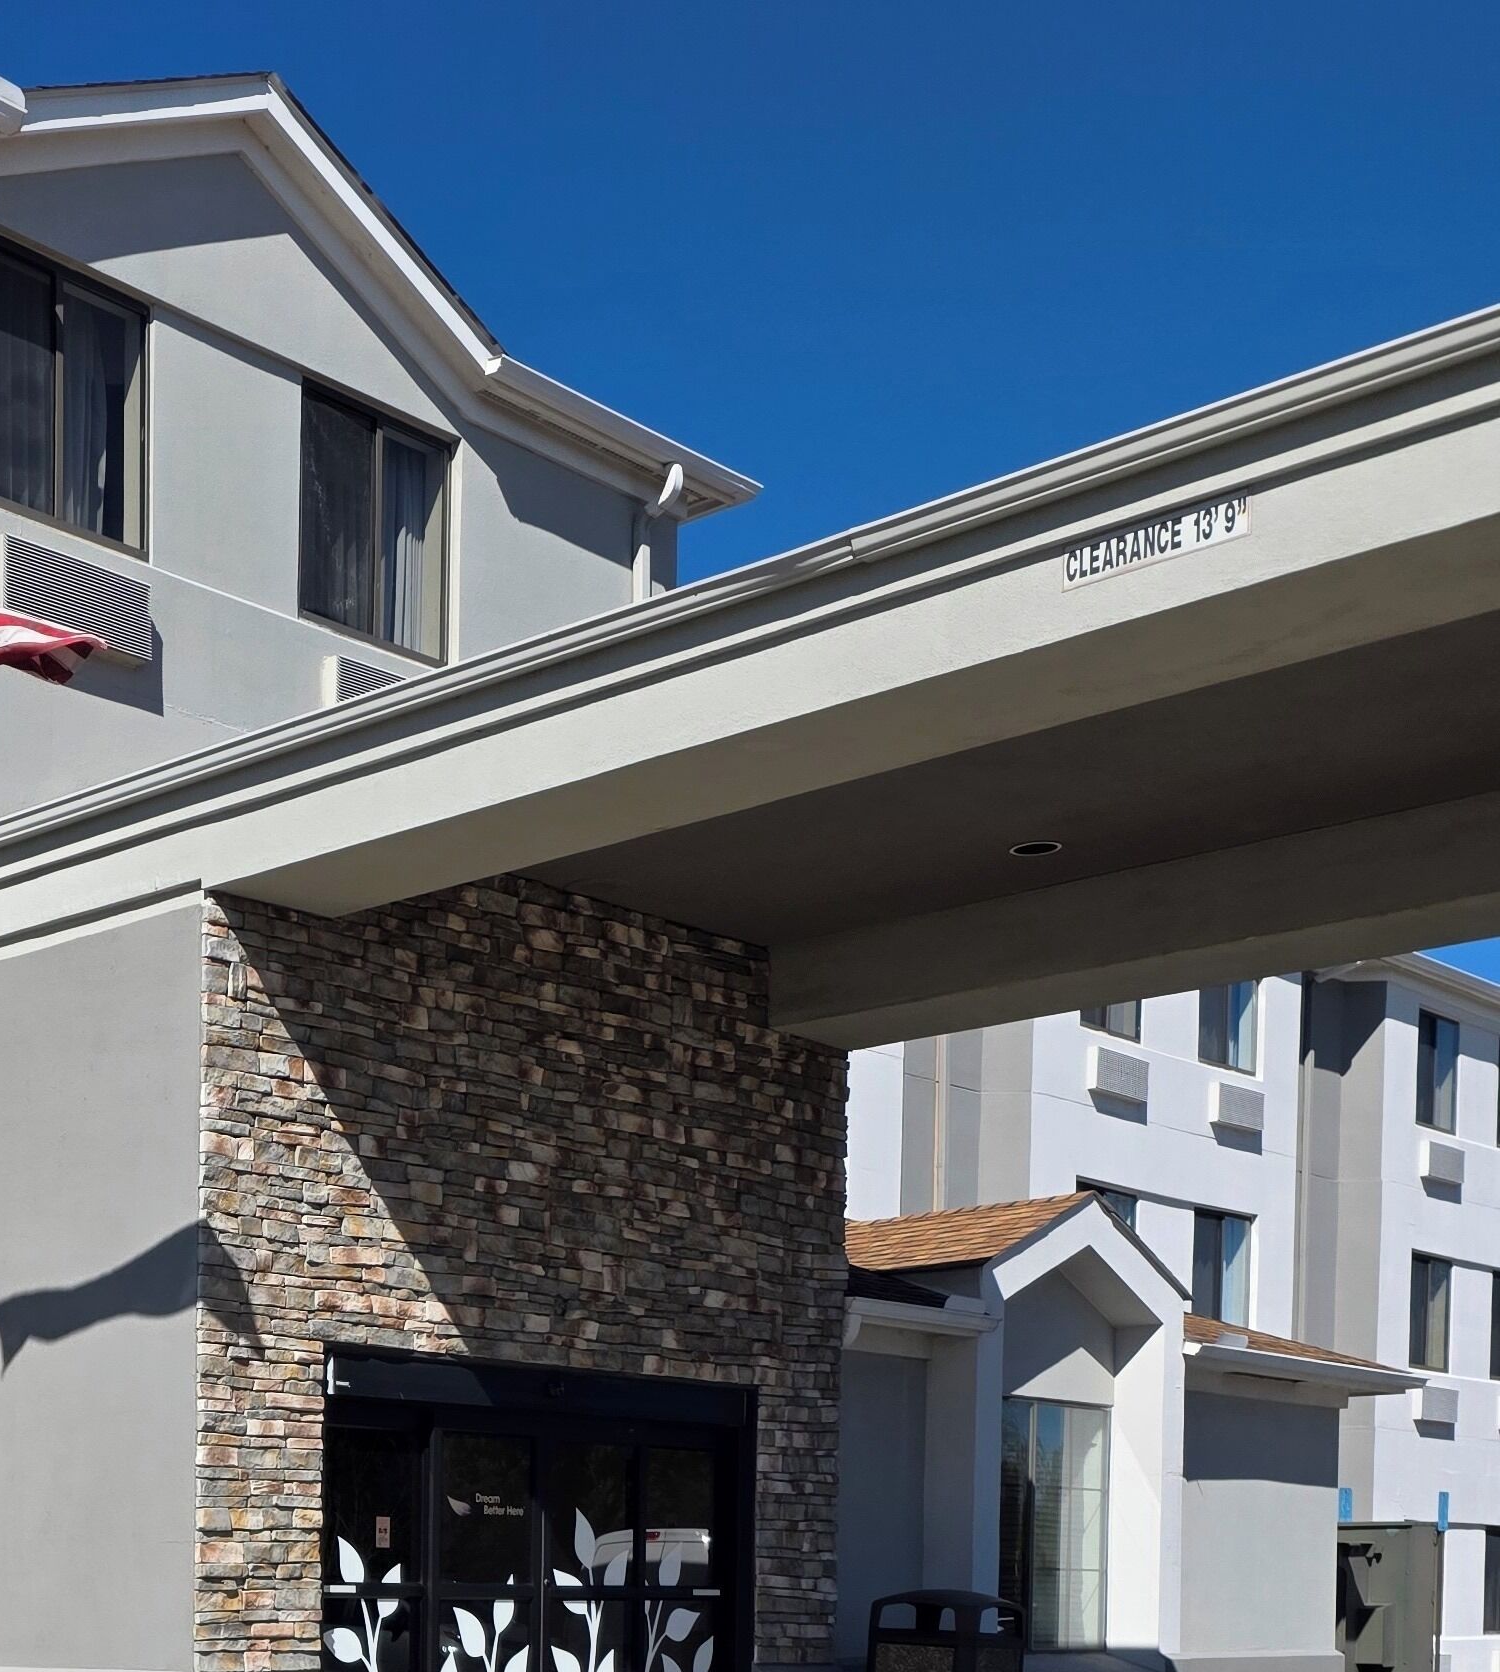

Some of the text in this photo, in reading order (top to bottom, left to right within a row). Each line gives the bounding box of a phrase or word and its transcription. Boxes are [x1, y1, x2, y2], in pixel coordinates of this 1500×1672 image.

[1066, 517, 1182, 582] CLEARANCE
[475, 1492, 501, 1504] Dream
[483, 1504, 505, 1515] Better
